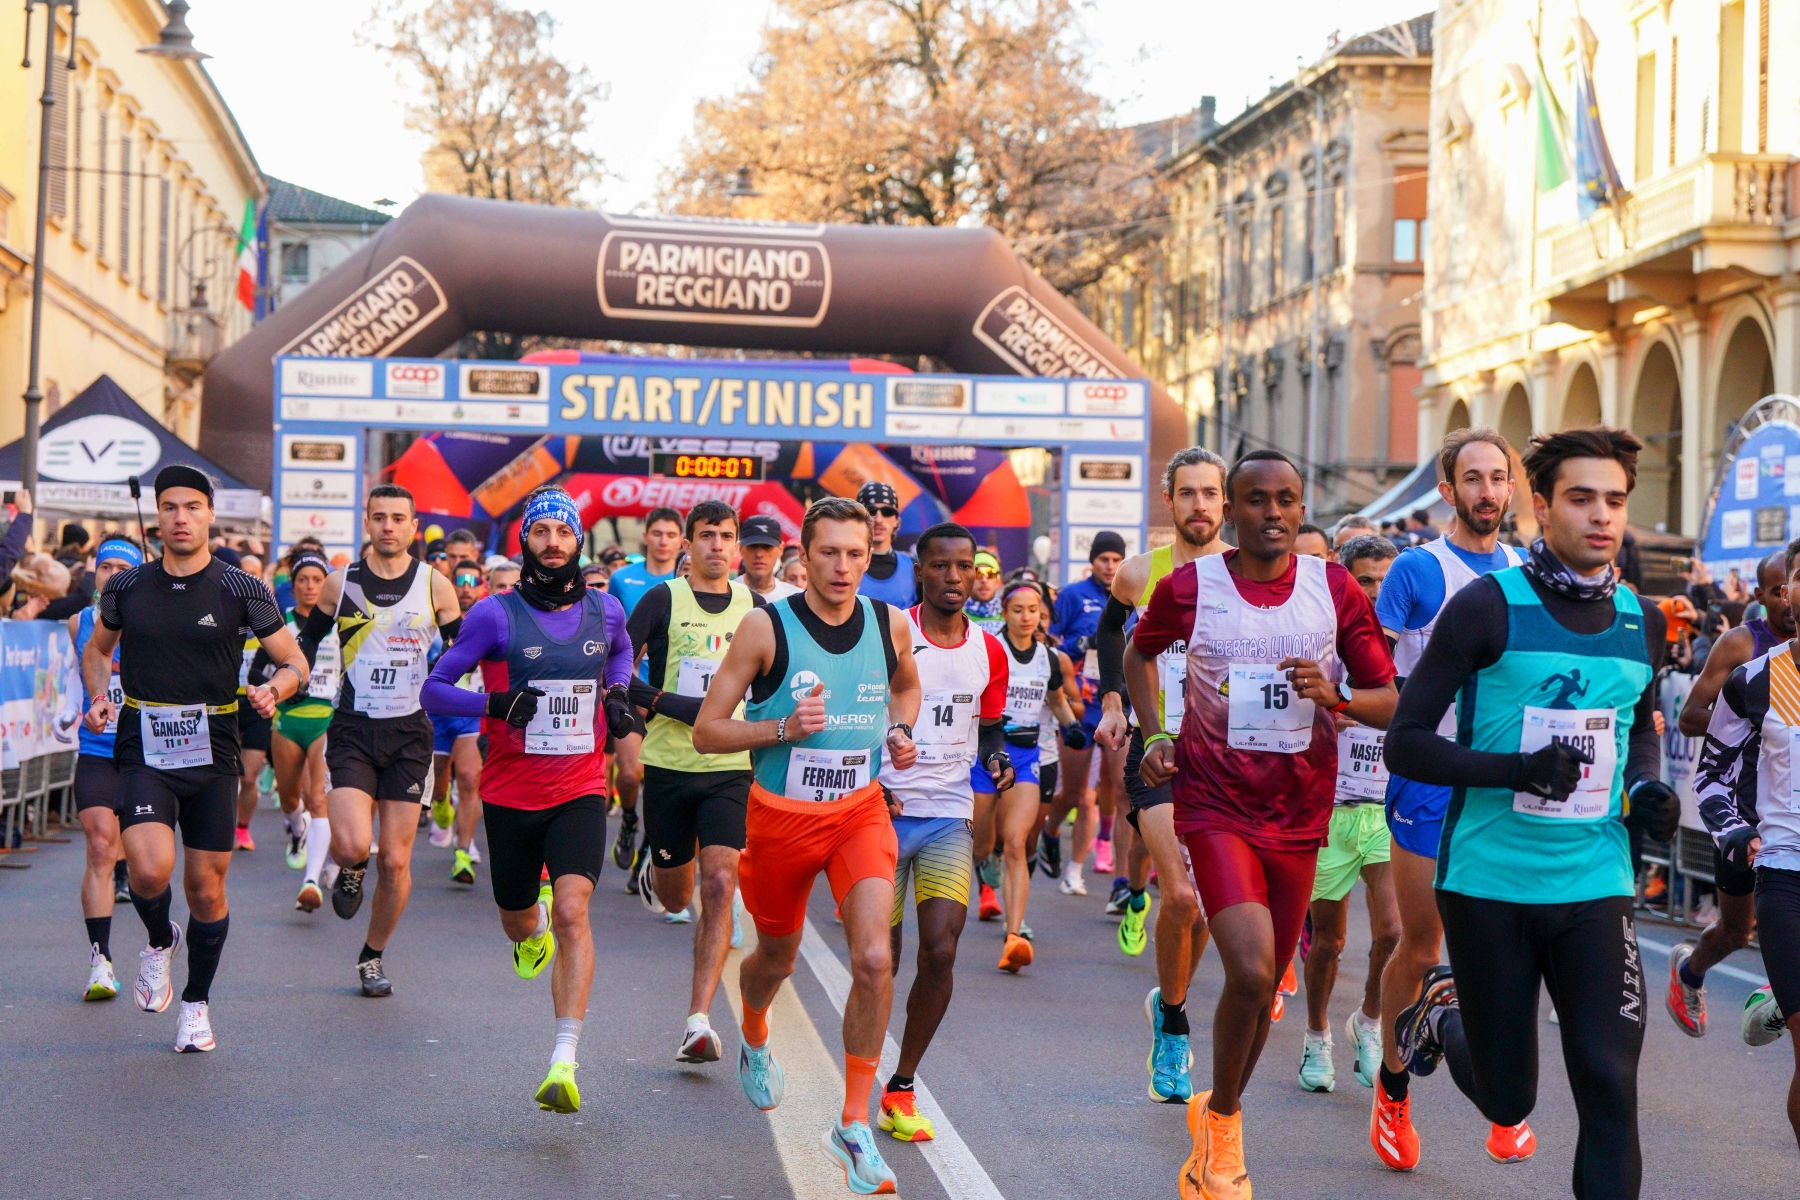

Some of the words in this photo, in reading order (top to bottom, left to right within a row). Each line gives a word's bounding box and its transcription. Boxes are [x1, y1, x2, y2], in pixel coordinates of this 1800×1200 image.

[619, 240, 811, 280] PARMIGIANO
[636, 273, 792, 311] REGGIANO
[291, 269, 415, 357] ARMIGIANO
[297, 369, 358, 390] Riunite
[391, 366, 439, 384] coop
[560, 374, 873, 429] START/FINISH
[1084, 386, 1127, 402] coop
[676, 455, 753, 478] 0:00:07
[641, 481, 751, 510] ENERVIT
[1204, 637, 1267, 658] LIBERTAS
[370, 668, 397, 685] 477
[548, 696, 579, 715] LOLLO
[1260, 683, 1289, 710] 15
[552, 716, 561, 729] 6
[932, 704, 954, 727] 14
[152, 719, 198, 738] GANASSI
[164, 738, 175, 749] 11
[1278, 739, 1306, 750] Riunite
[182, 756, 206, 765] Riunite
[1353, 760, 1361, 772] 8
[802, 766, 856, 789] FERRATO
[814, 789, 824, 802] 3
[1574, 803, 1603, 815] Riunite
[1620, 915, 1640, 1022] NIKE
